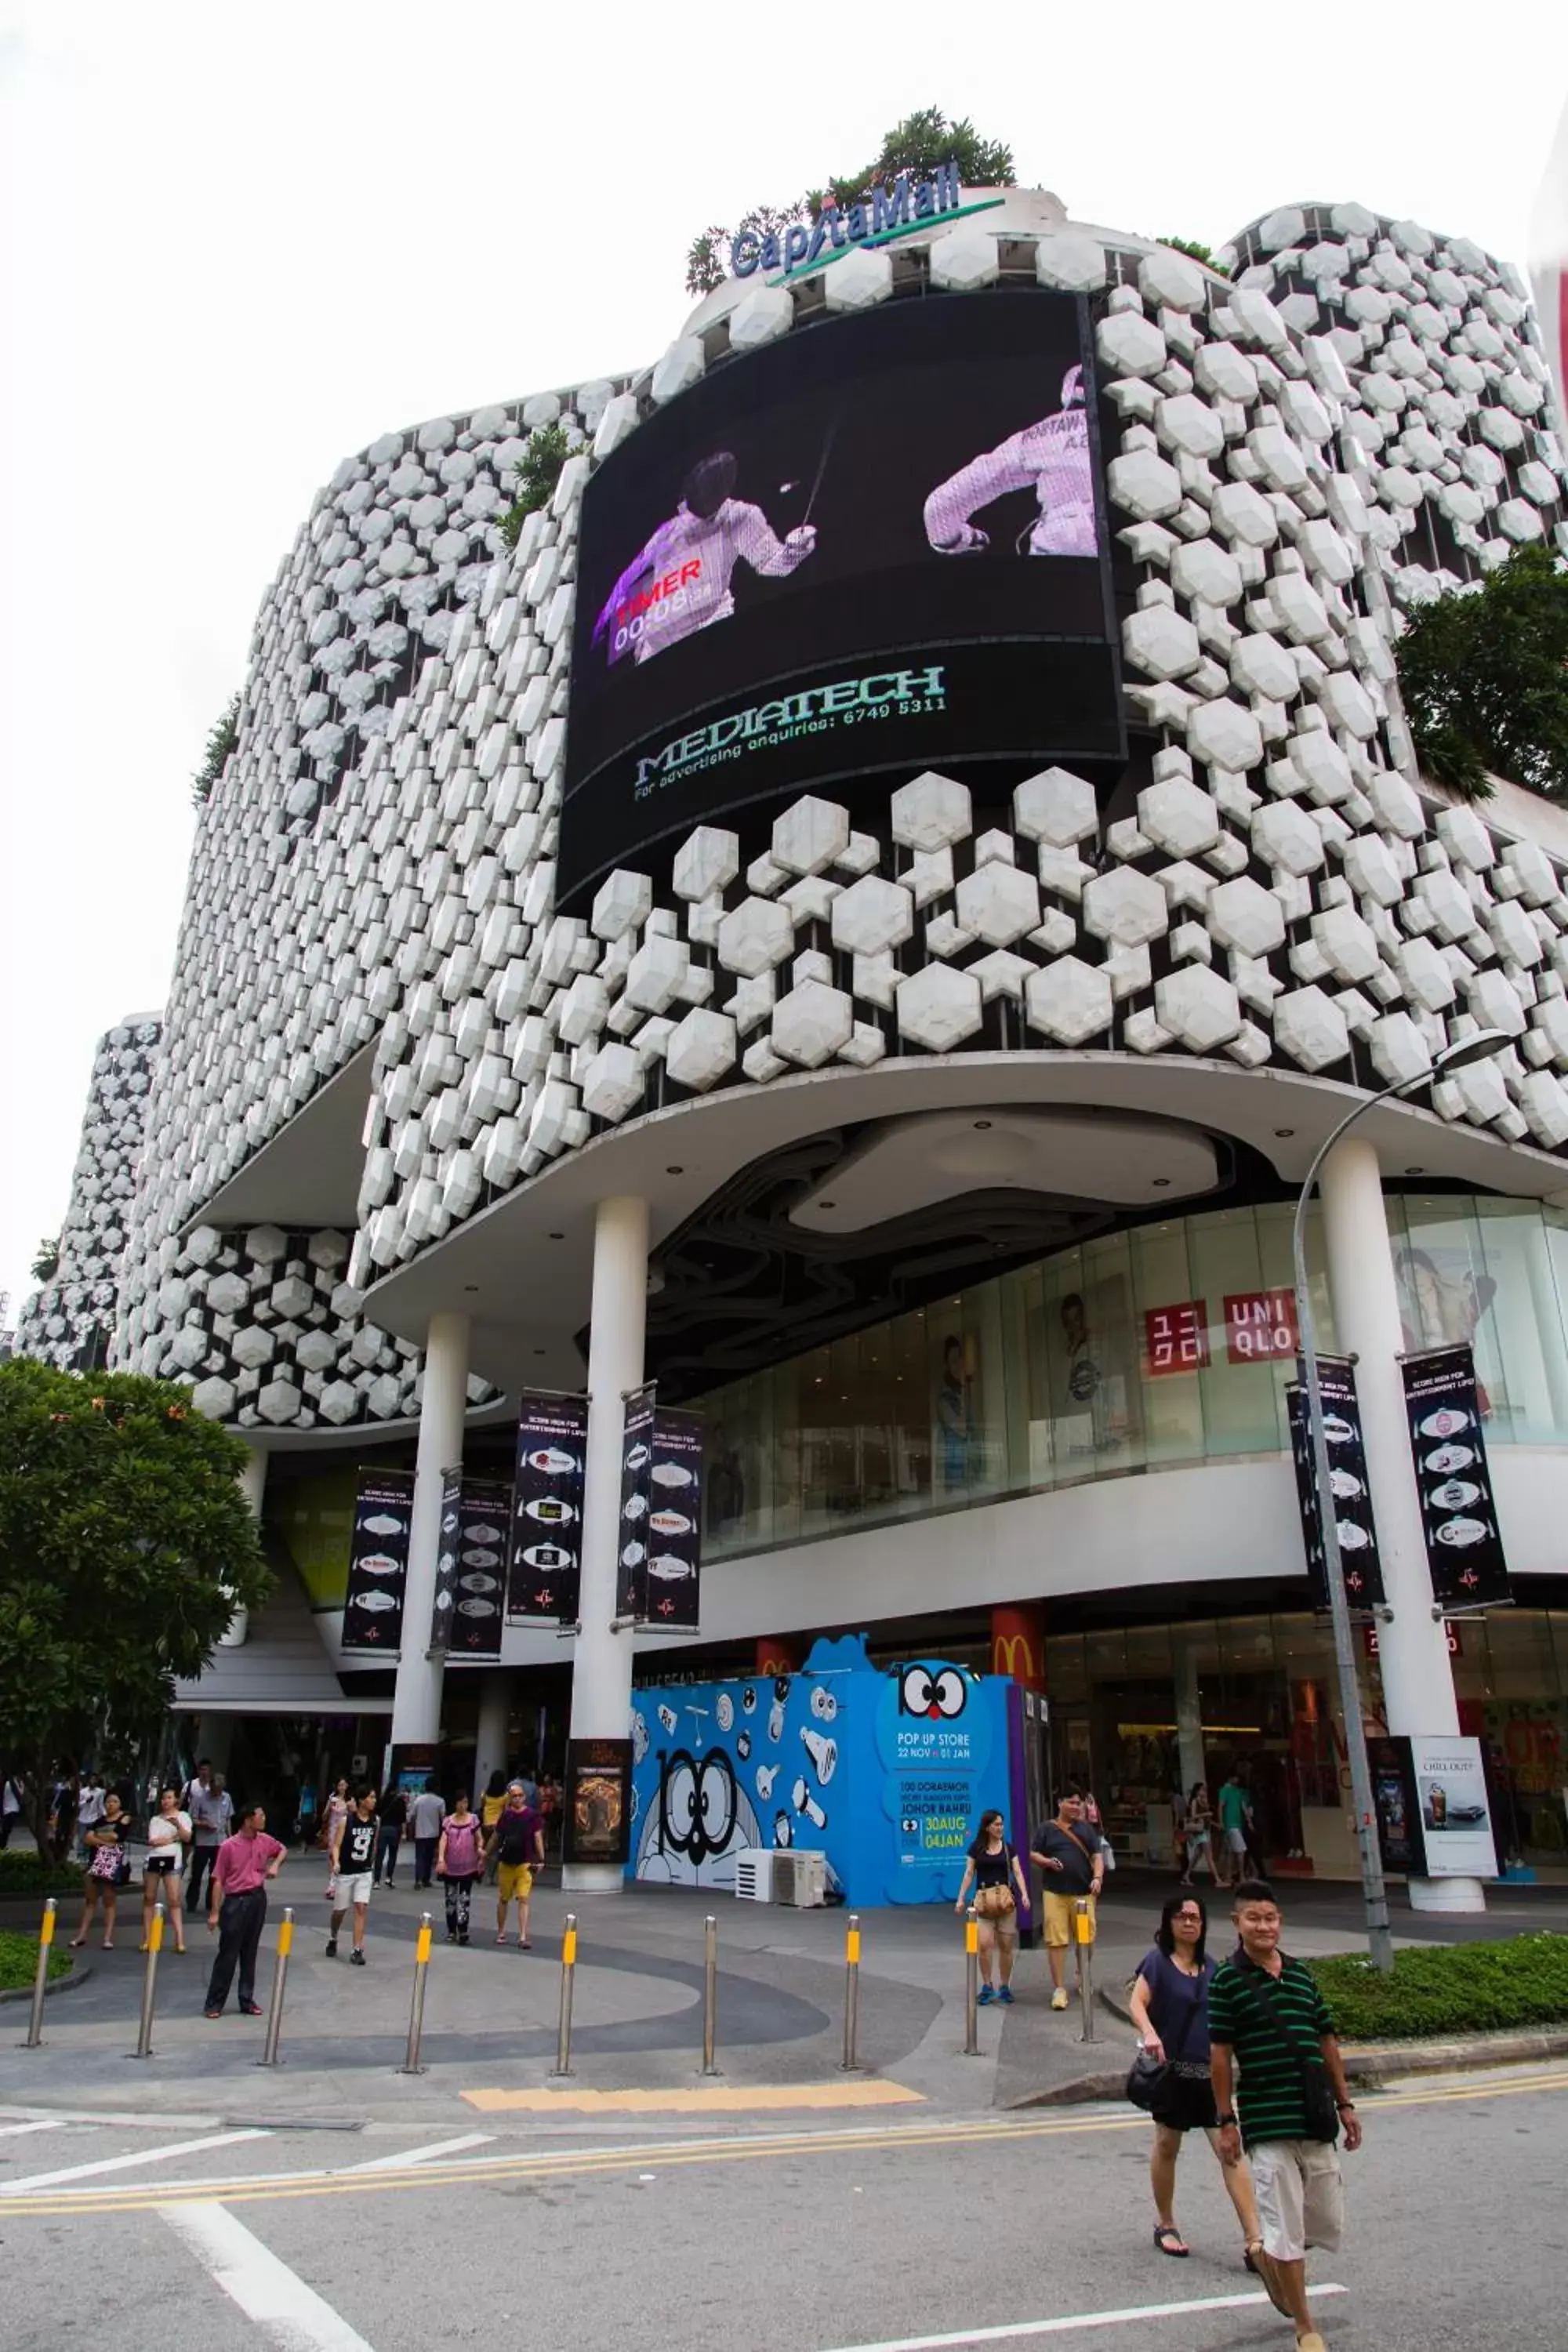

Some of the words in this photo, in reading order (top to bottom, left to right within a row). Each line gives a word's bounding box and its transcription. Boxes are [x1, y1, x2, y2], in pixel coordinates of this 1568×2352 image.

[730, 160, 959, 278] CapitaMall
[617, 559, 701, 628] TIMER
[635, 666, 945, 786] MEDIATECH
[659, 744, 742, 788] advertising
[898, 696, 946, 714] 5311
[1232, 1298, 1284, 1326] UNI
[1235, 1327, 1292, 1357] QLO
[898, 1733, 920, 1745] POP
[923, 1733, 935, 1746] UP
[938, 1733, 970, 1747] STORE
[898, 1748, 909, 1758] 22
[910, 1748, 931, 1758] NOV
[953, 1749, 970, 1759] JAN
[917, 1781, 969, 1791] DORAEMON
[901, 1802, 935, 1815] JOHOR
